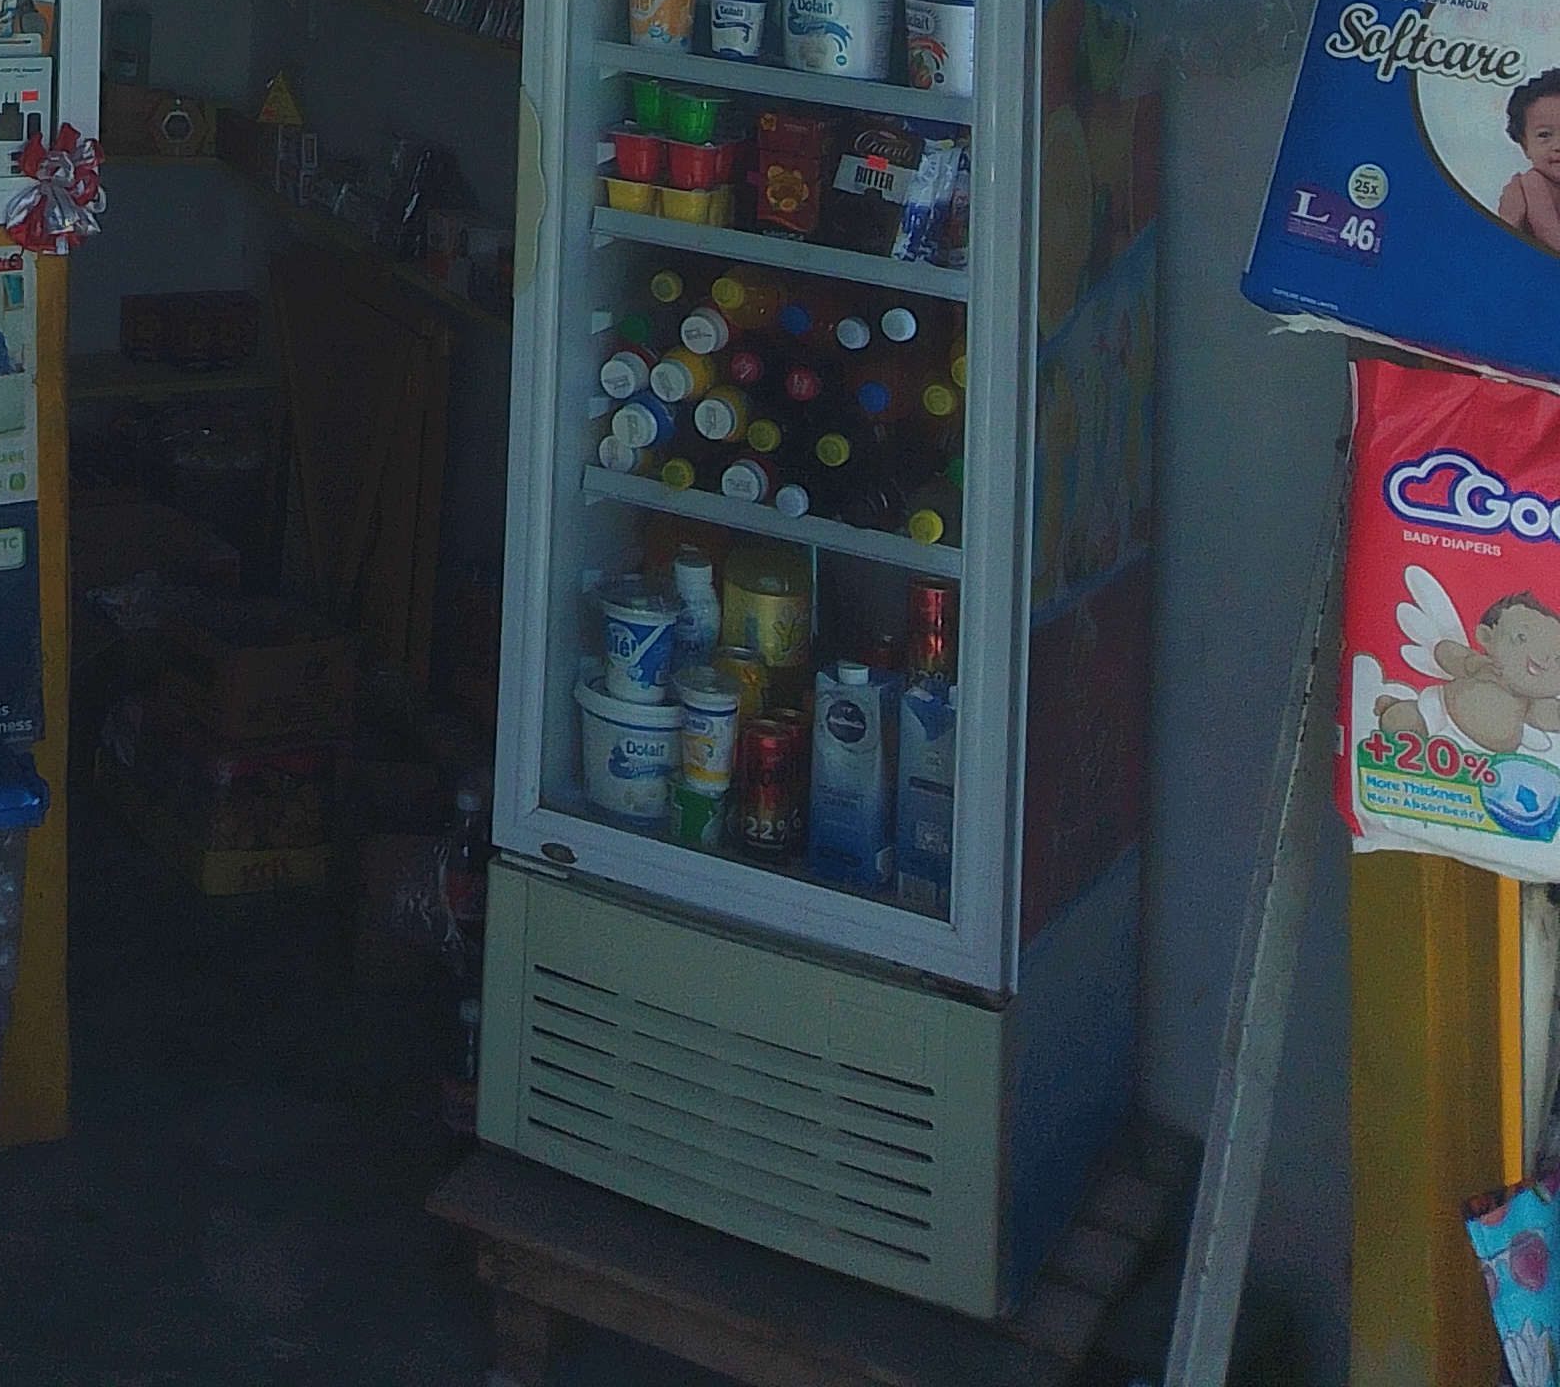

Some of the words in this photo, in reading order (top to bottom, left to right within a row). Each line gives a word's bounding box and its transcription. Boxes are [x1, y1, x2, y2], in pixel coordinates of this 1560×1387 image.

[1327, 4, 1525, 83] Softcare
[854, 164, 895, 191] BITTER
[1353, 178, 1379, 196] 25x
[1290, 188, 1331, 223] L
[1340, 215, 1376, 252] 46
[1403, 529, 1439, 548] BABY
[1441, 535, 1502, 558] DIAPERS
[1364, 731, 1497, 785] +20%
[1365, 774, 1398, 793] More
[1400, 780, 1473, 806] Thickness
[1402, 795, 1485, 824] Absorbency
